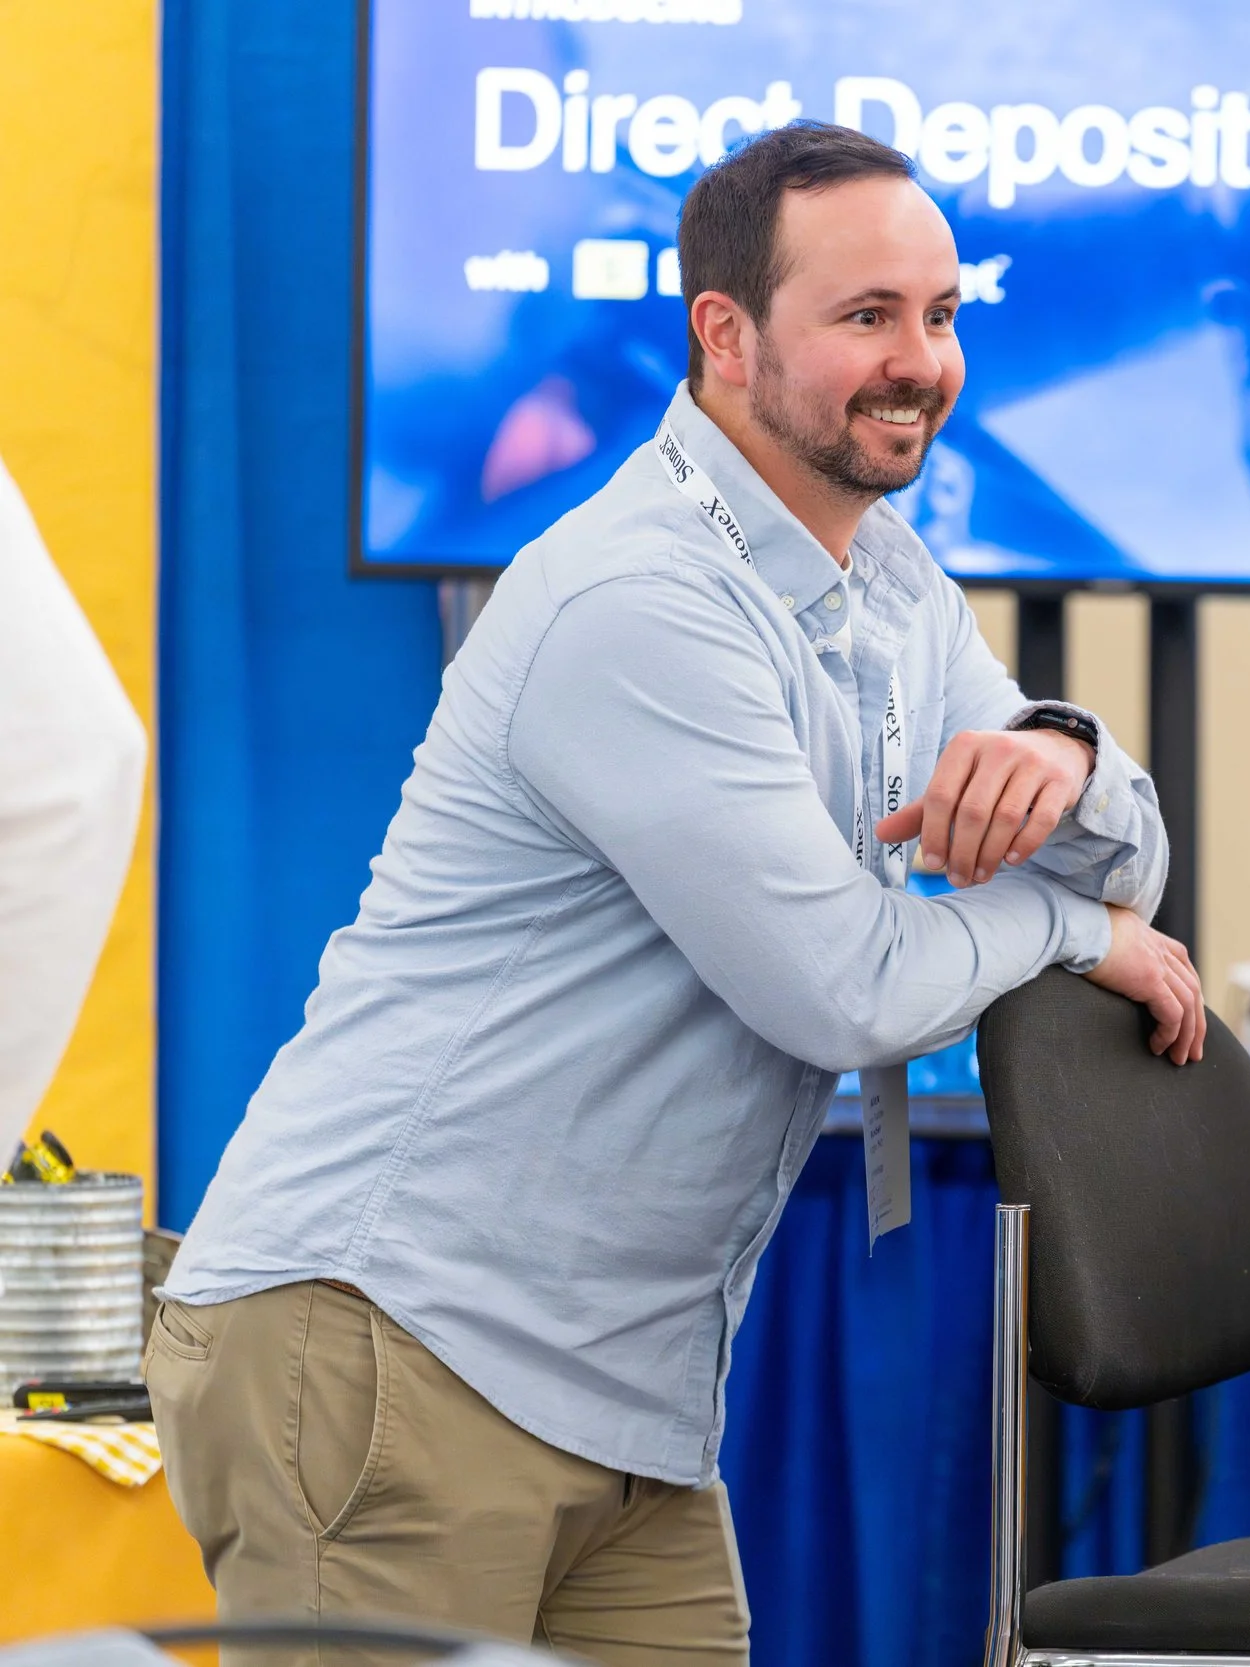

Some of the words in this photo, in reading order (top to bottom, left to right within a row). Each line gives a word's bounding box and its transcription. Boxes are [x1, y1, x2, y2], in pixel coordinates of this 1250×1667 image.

[475, 66, 802, 178] Direct
[659, 434, 694, 484] StoneX
[701, 496, 754, 569] toneX
[887, 775, 903, 862] StoX
